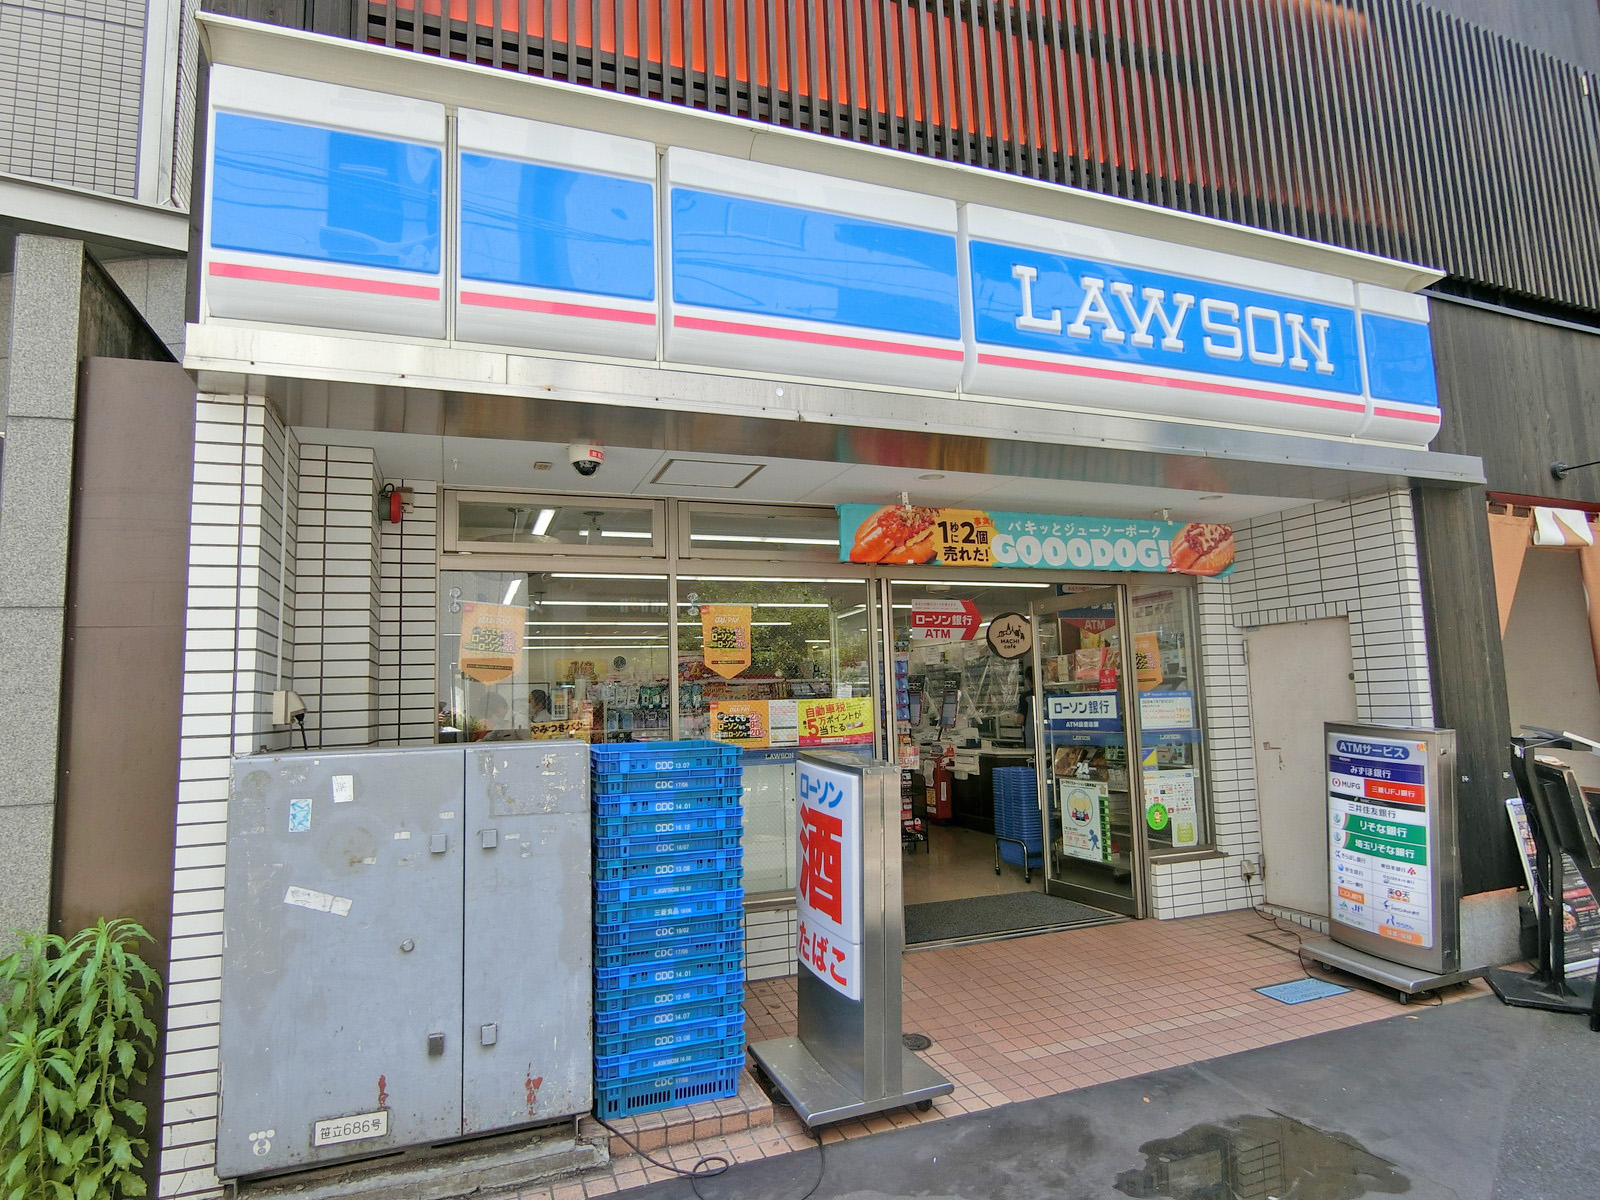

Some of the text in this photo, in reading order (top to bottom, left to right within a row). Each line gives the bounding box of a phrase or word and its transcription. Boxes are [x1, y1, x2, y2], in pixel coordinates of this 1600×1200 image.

[1012, 263, 1335, 375] LAWSON
[943, 545, 989, 562] 売れた!
[990, 533, 1172, 568] GOOODOG!
[915, 614, 972, 626] ローソン銀行
[1084, 619, 1106, 630] ATM
[925, 629, 951, 639] ATM
[805, 702, 846, 718] 自動車税
[1053, 700, 1110, 714] ローソン銀行
[819, 723, 846, 735] 当たる
[765, 752, 795, 760] LAWSON
[1338, 742, 1405, 758] ATMサービス
[655, 761, 674, 770] CDC
[1349, 765, 1392, 779] みずほ銀行
[655, 780, 674, 789] CDC
[800, 772, 844, 809] ローソン
[1341, 780, 1361, 790] MUFG
[1371, 785, 1416, 798] 三菱UFJ銀行
[655, 802, 674, 811] CDC
[1348, 803, 1396, 819] 三井住友銀行
[655, 823, 674, 832] CDC
[1359, 820, 1408, 838] りそな銀行
[656, 843, 675, 852] CDC
[1354, 838, 1415, 859] 埼玉りそな銀行
[655, 864, 674, 874] CDC
[799, 801, 843, 925] 酒
[655, 927, 675, 937] CDC
[654, 948, 674, 958] CDC
[798, 919, 848, 987] たばこ
[655, 970, 691, 981] CDC 14.01
[654, 993, 674, 1004] CDC
[654, 1012, 691, 1024] CDC 14.07
[654, 1035, 674, 1046] CDC
[654, 1077, 674, 1087] CDC
[320, 1118, 382, 1140] 笹立686号
